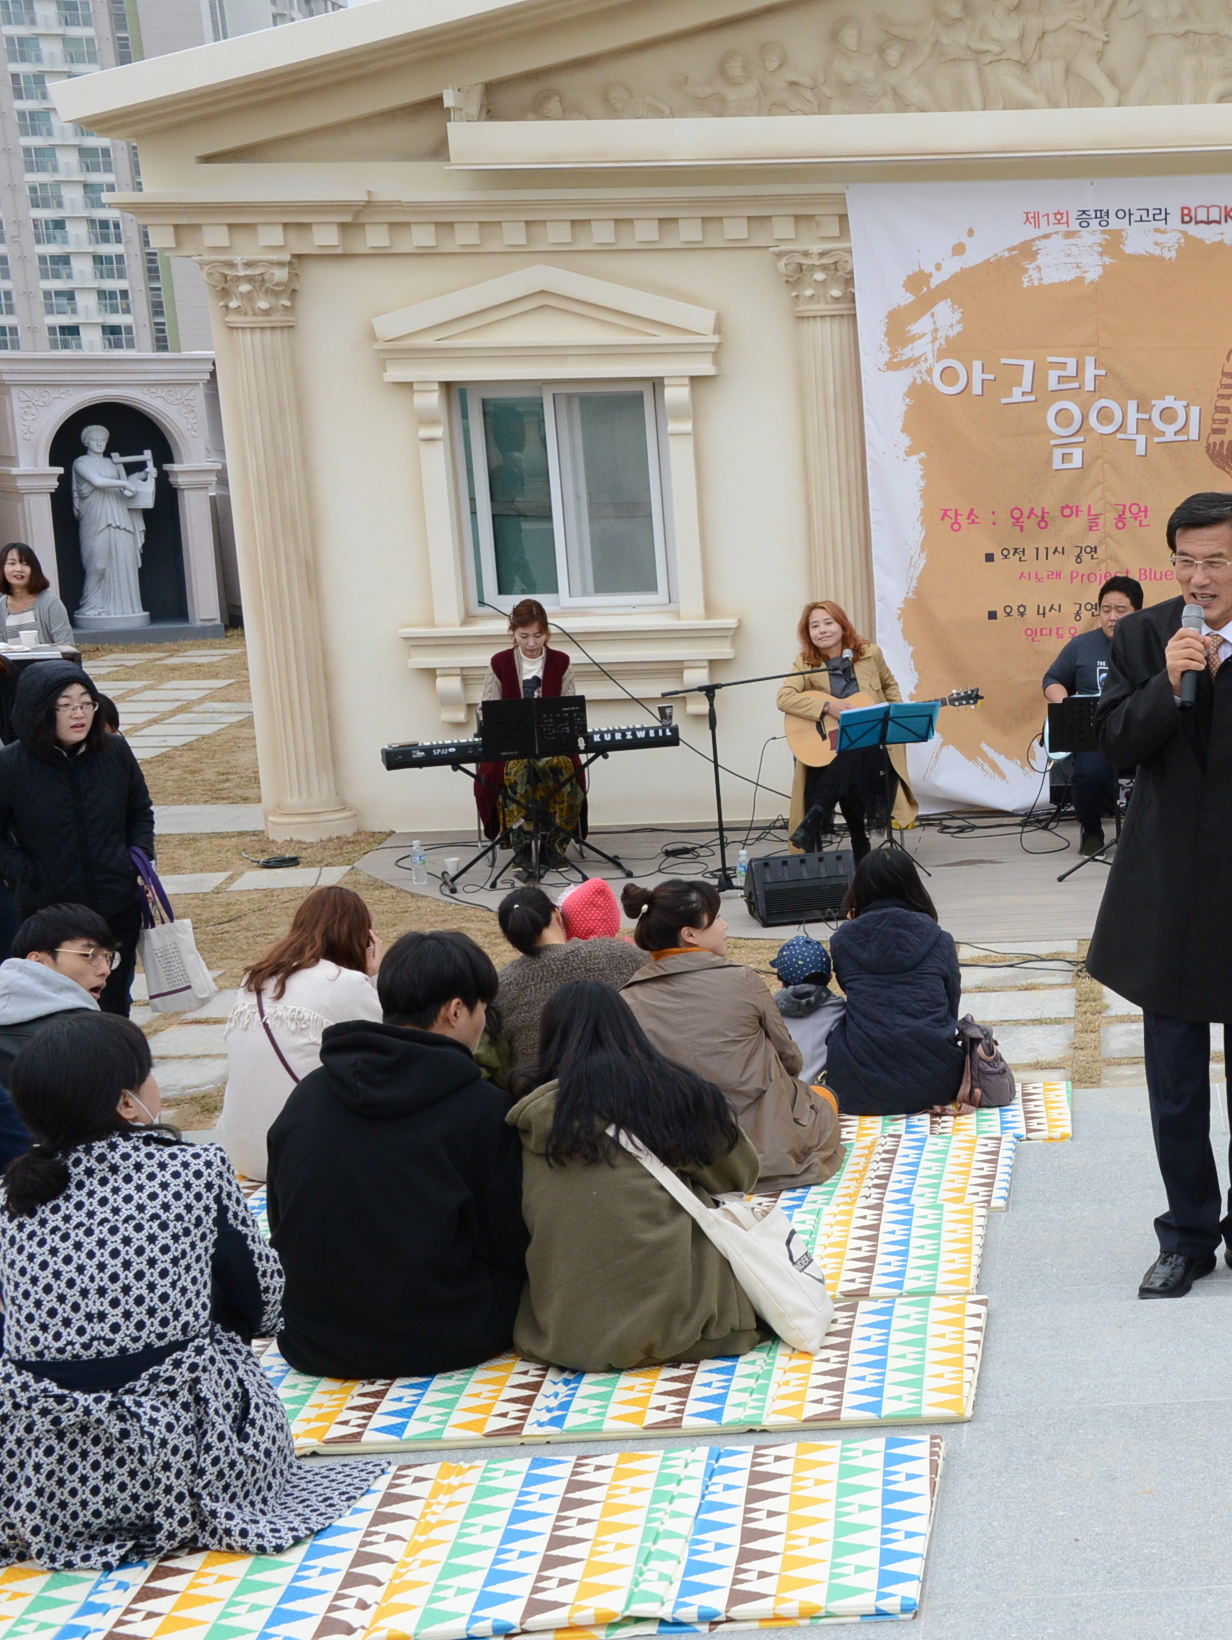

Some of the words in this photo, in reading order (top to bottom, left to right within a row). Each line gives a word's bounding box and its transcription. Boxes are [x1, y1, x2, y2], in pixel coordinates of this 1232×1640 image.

[1022, 210, 1071, 229] 제1회
[1075, 208, 1110, 229] 증평
[1115, 207, 1171, 227] 아고라
[932, 355, 1107, 405] 아고라
[1046, 395, 1201, 471] 음악회
[939, 507, 980, 532] 장소
[1009, 506, 1050, 532] 옥상
[1060, 503, 1100, 532] 하늘
[1113, 502, 1151, 531] 공원
[1000, 546, 1028, 563] 오전
[1034, 545, 1066, 562] 11시
[1074, 545, 1100, 565] 공연
[1018, 570, 1063, 583] 시노래
[1003, 603, 1028, 618] 오후
[1036, 603, 1062, 618] 4시
[1073, 602, 1100, 622] 공연
[593, 728, 672, 742] KURZWEIL
